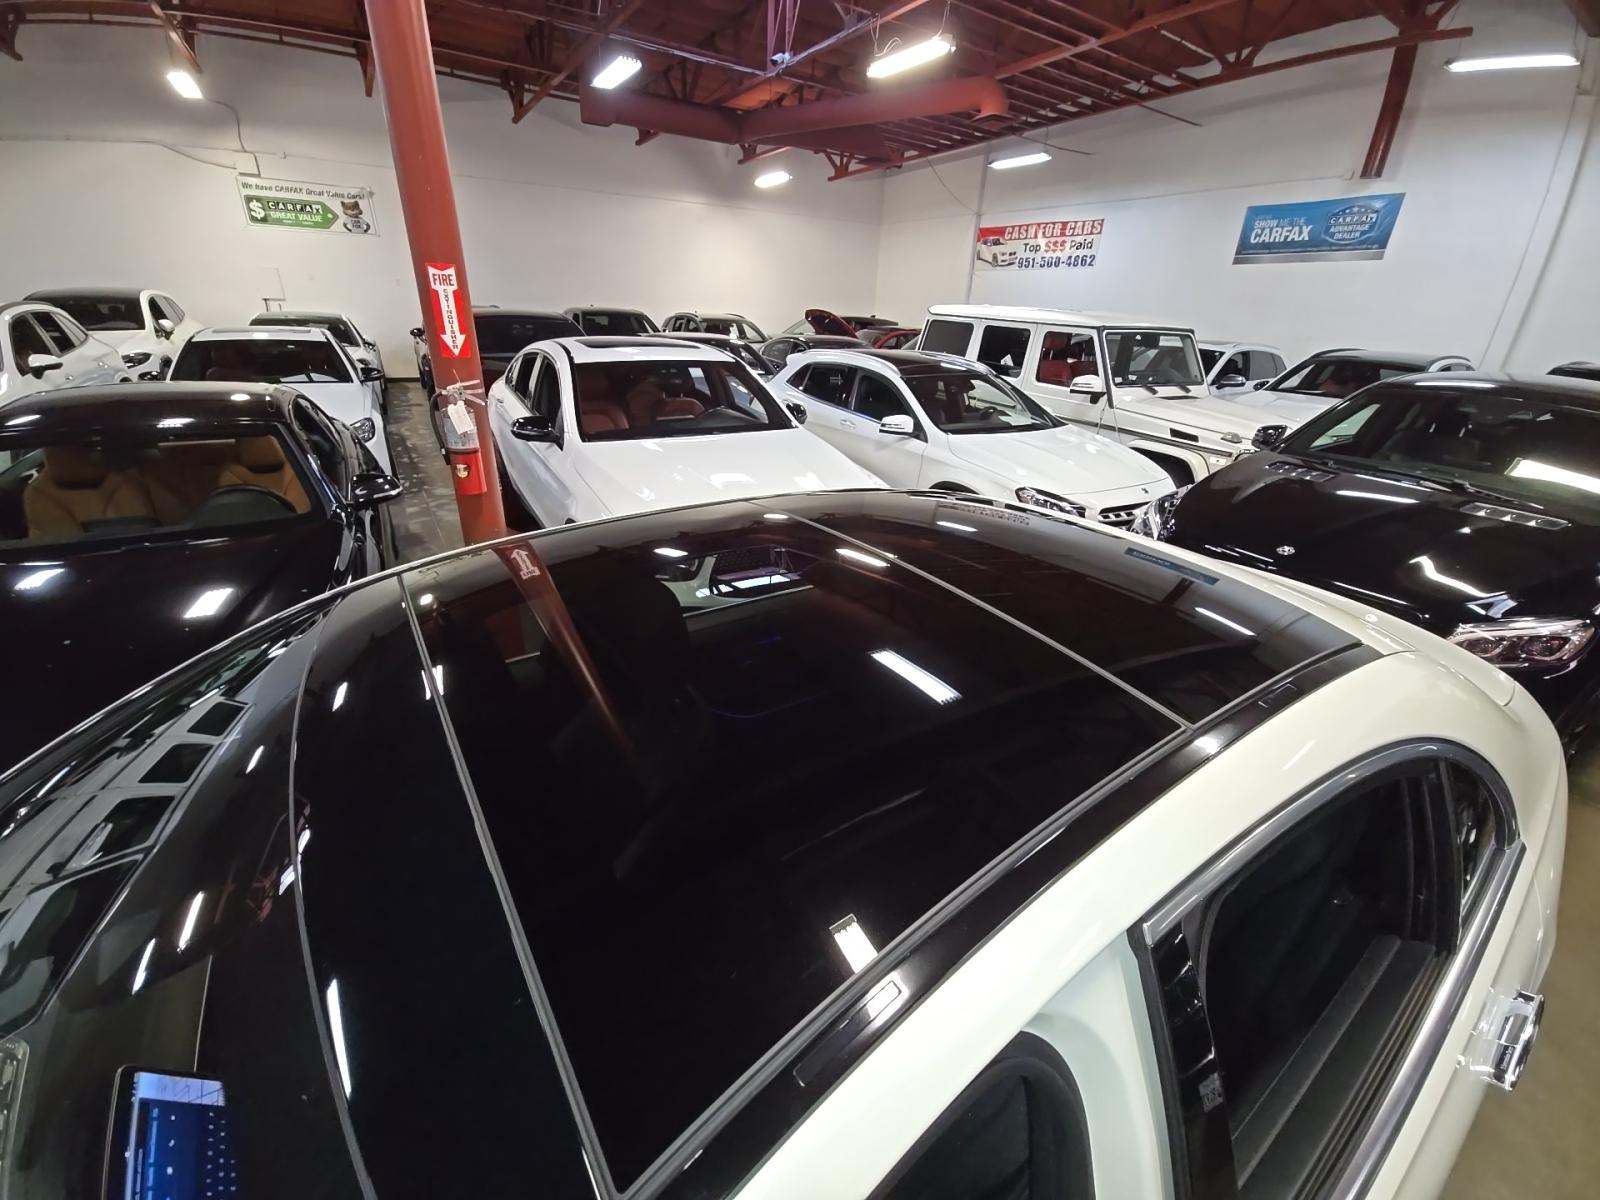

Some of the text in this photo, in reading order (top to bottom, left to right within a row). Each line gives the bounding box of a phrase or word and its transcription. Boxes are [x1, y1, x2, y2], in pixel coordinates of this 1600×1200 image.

[241, 182, 253, 190] We
[255, 183, 273, 191] have
[274, 185, 303, 195] CARFAX
[305, 188, 324, 197] Great
[325, 189, 345, 199] Value
[267, 201, 323, 214] CARFAX
[270, 211, 323, 222] GREAT VALUE
[1328, 213, 1377, 226] CARFAX
[1004, 220, 1102, 240] CASH FOR CARS
[1254, 219, 1279, 229] SHOW
[1329, 224, 1370, 233] ADVANTAGE
[1250, 225, 1314, 243] CARFAX
[1333, 232, 1360, 240] DEALER
[1023, 238, 1095, 254] Top $$$ Paid
[431, 273, 455, 287] FIRE
